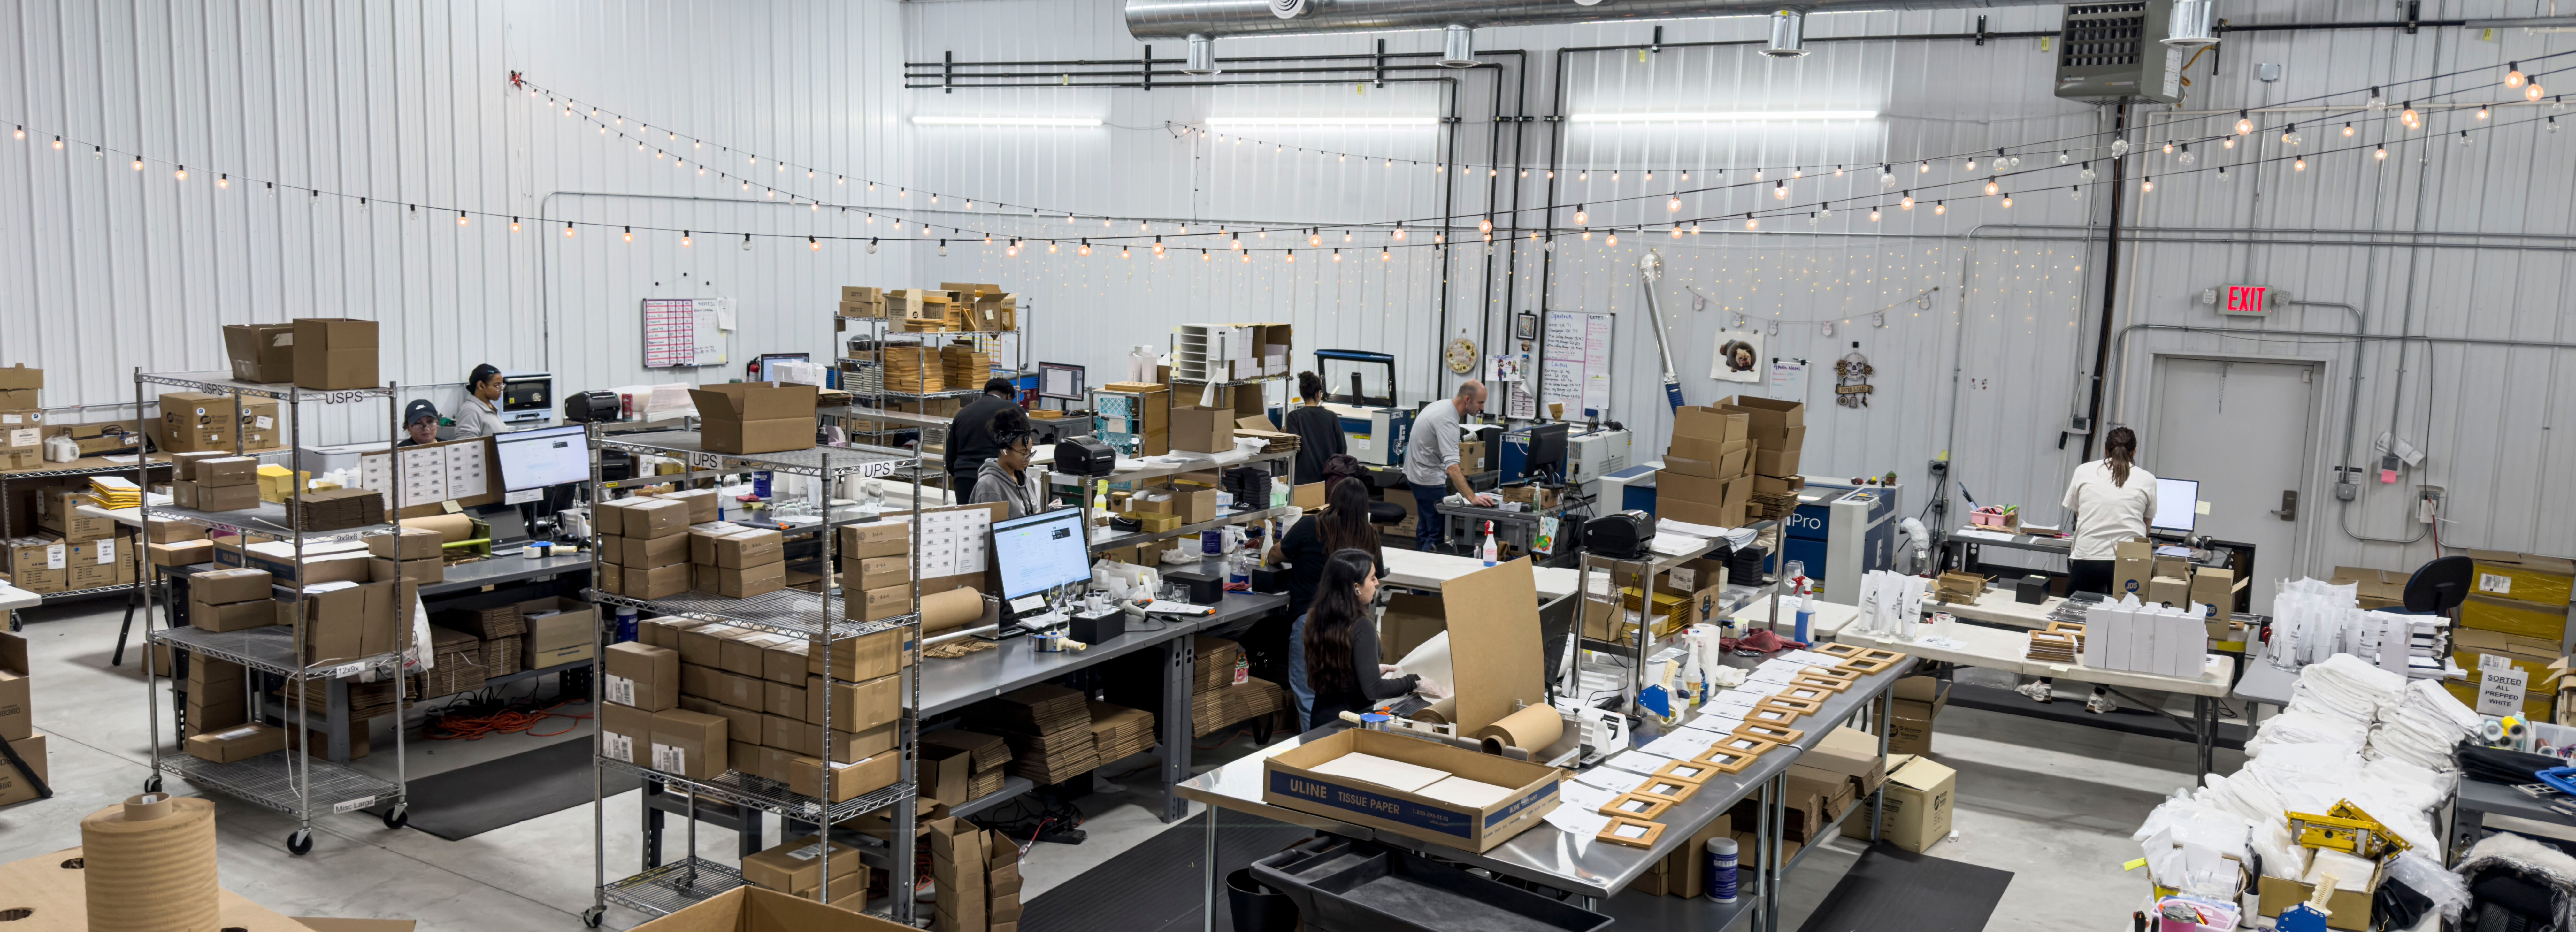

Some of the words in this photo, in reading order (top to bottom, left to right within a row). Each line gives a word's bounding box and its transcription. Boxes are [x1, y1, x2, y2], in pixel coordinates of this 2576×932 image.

[2228, 286, 2266, 312] EXIT
[201, 383, 223, 396] USPS
[326, 391, 363, 404] USPS
[694, 453, 717, 468] UPS
[865, 462, 890, 477] UPS
[337, 533, 358, 542] 9x9x6
[339, 666, 359, 674] 12x9x
[2488, 675, 2521, 685] SORTED
[2485, 691, 2518, 700] PREPPED
[2489, 699, 2511, 707] WHITE
[1290, 779, 1327, 798] ULINE
[354, 799, 373, 808] Large
[1338, 791, 1367, 807] TISSUE
[1370, 799, 1399, 814] PAPER
[1509, 803, 1520, 814] ULINE
